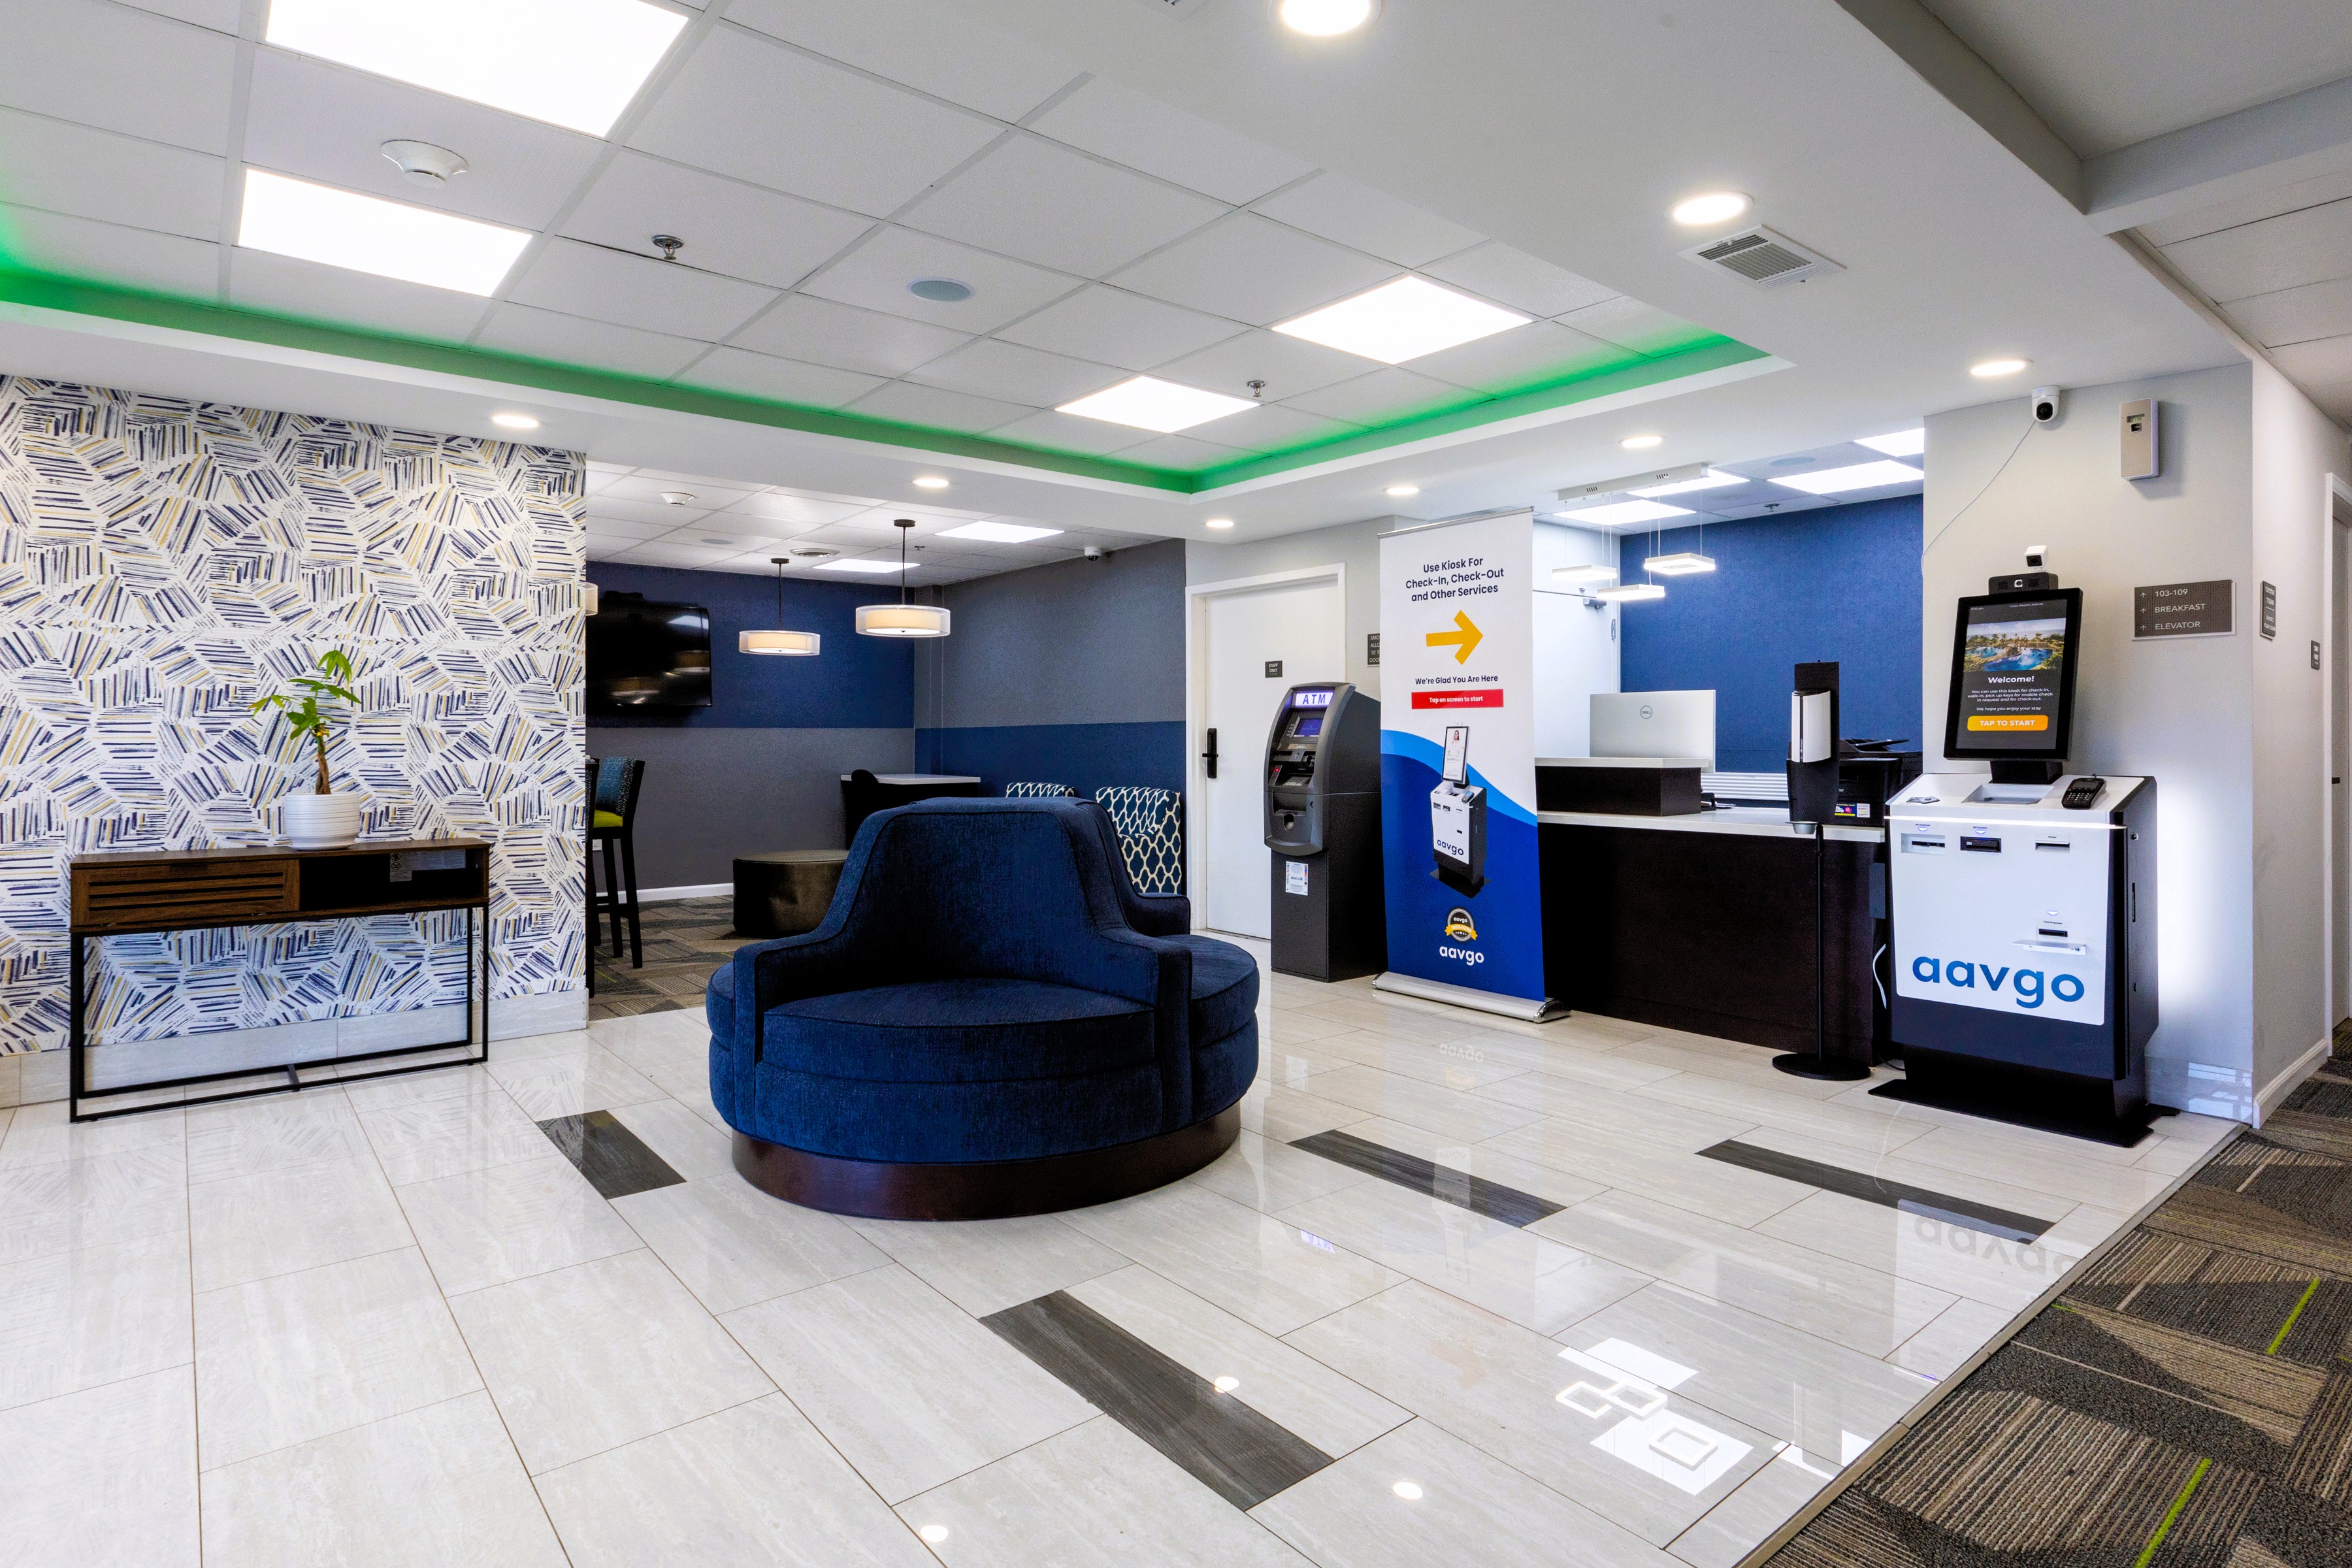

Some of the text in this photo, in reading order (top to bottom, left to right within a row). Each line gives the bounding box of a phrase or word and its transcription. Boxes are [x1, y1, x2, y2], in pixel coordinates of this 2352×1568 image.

[1423, 558, 1483, 573] Use Kiosk For
[1405, 568, 1504, 589] Check-In, Check-Out
[1411, 584, 1498, 602] and Other Services
[2155, 589, 2188, 597] 103-109
[2155, 603, 2206, 613] BREAKFAST
[2155, 621, 2200, 630] ELEVATOR
[1302, 694, 1326, 704] ATM
[1437, 840, 1464, 856] aavgo
[1439, 945, 1484, 966] aavgo
[1912, 956, 2085, 1009] aavgo
